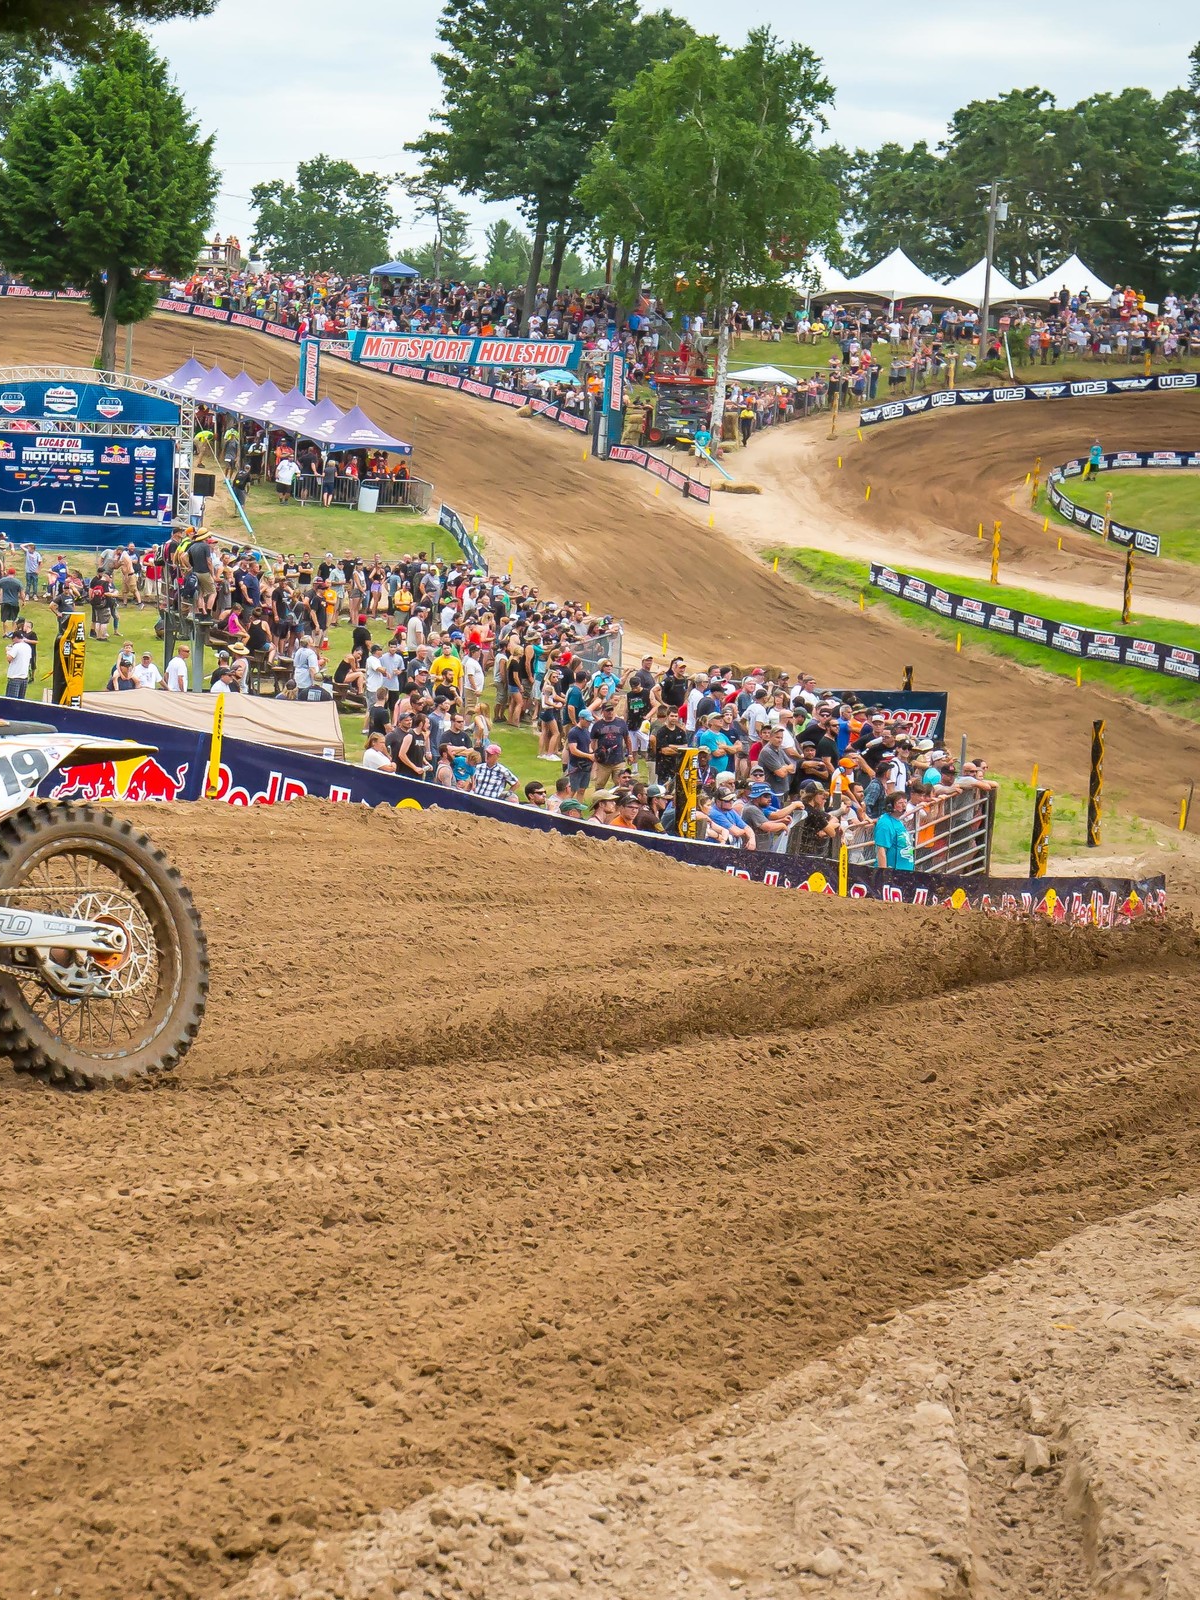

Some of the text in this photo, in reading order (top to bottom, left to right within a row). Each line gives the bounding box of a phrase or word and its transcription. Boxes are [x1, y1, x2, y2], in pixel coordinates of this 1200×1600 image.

[478, 342, 572, 365] HOLESHOT
[1158, 375, 1197, 388] WPS
[993, 388, 1026, 400] WPS
[1071, 382, 1108, 395] WPS
[932, 392, 956, 406] WPS
[38, 438, 80, 448] LUCAS OIL
[22, 450, 95, 463] MOTOCROSS
[1135, 531, 1158, 553] WPS
[72, 622, 86, 677] THE WICK
